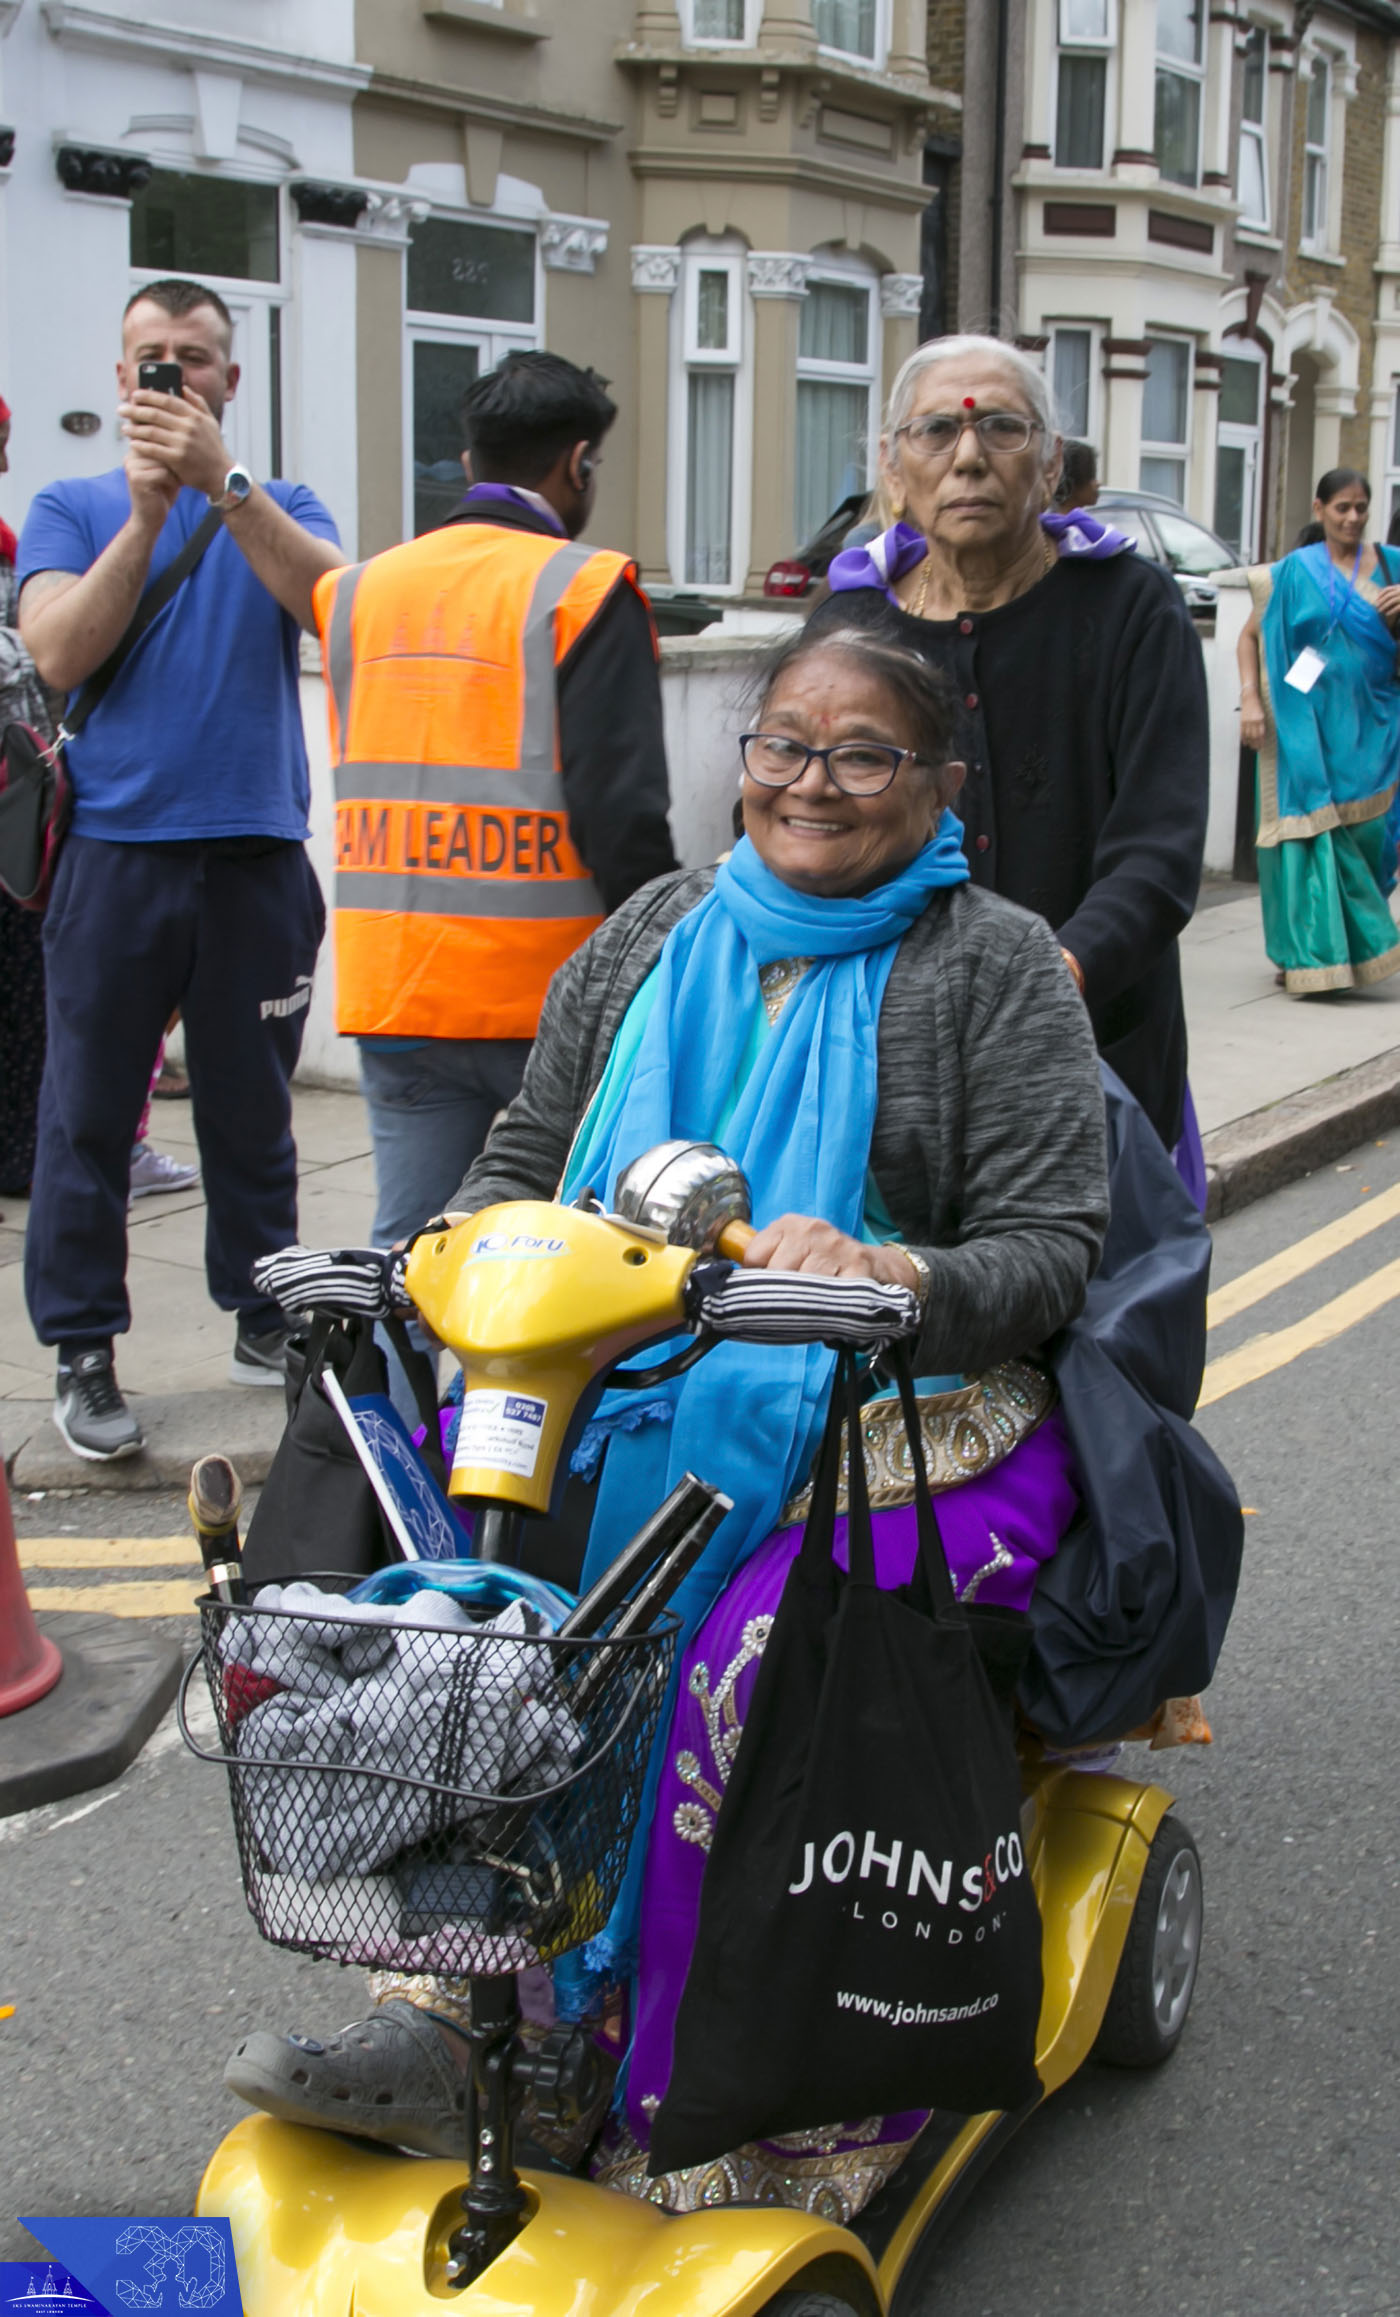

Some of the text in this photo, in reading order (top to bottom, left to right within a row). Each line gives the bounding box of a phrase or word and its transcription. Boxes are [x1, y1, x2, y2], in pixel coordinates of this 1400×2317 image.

[404, 811, 563, 874] LEADER
[788, 1830, 1024, 1912] JOHNS&CO
[853, 1901, 1001, 1944] LONDON
[836, 1991, 999, 2026] www.johnsand.co
